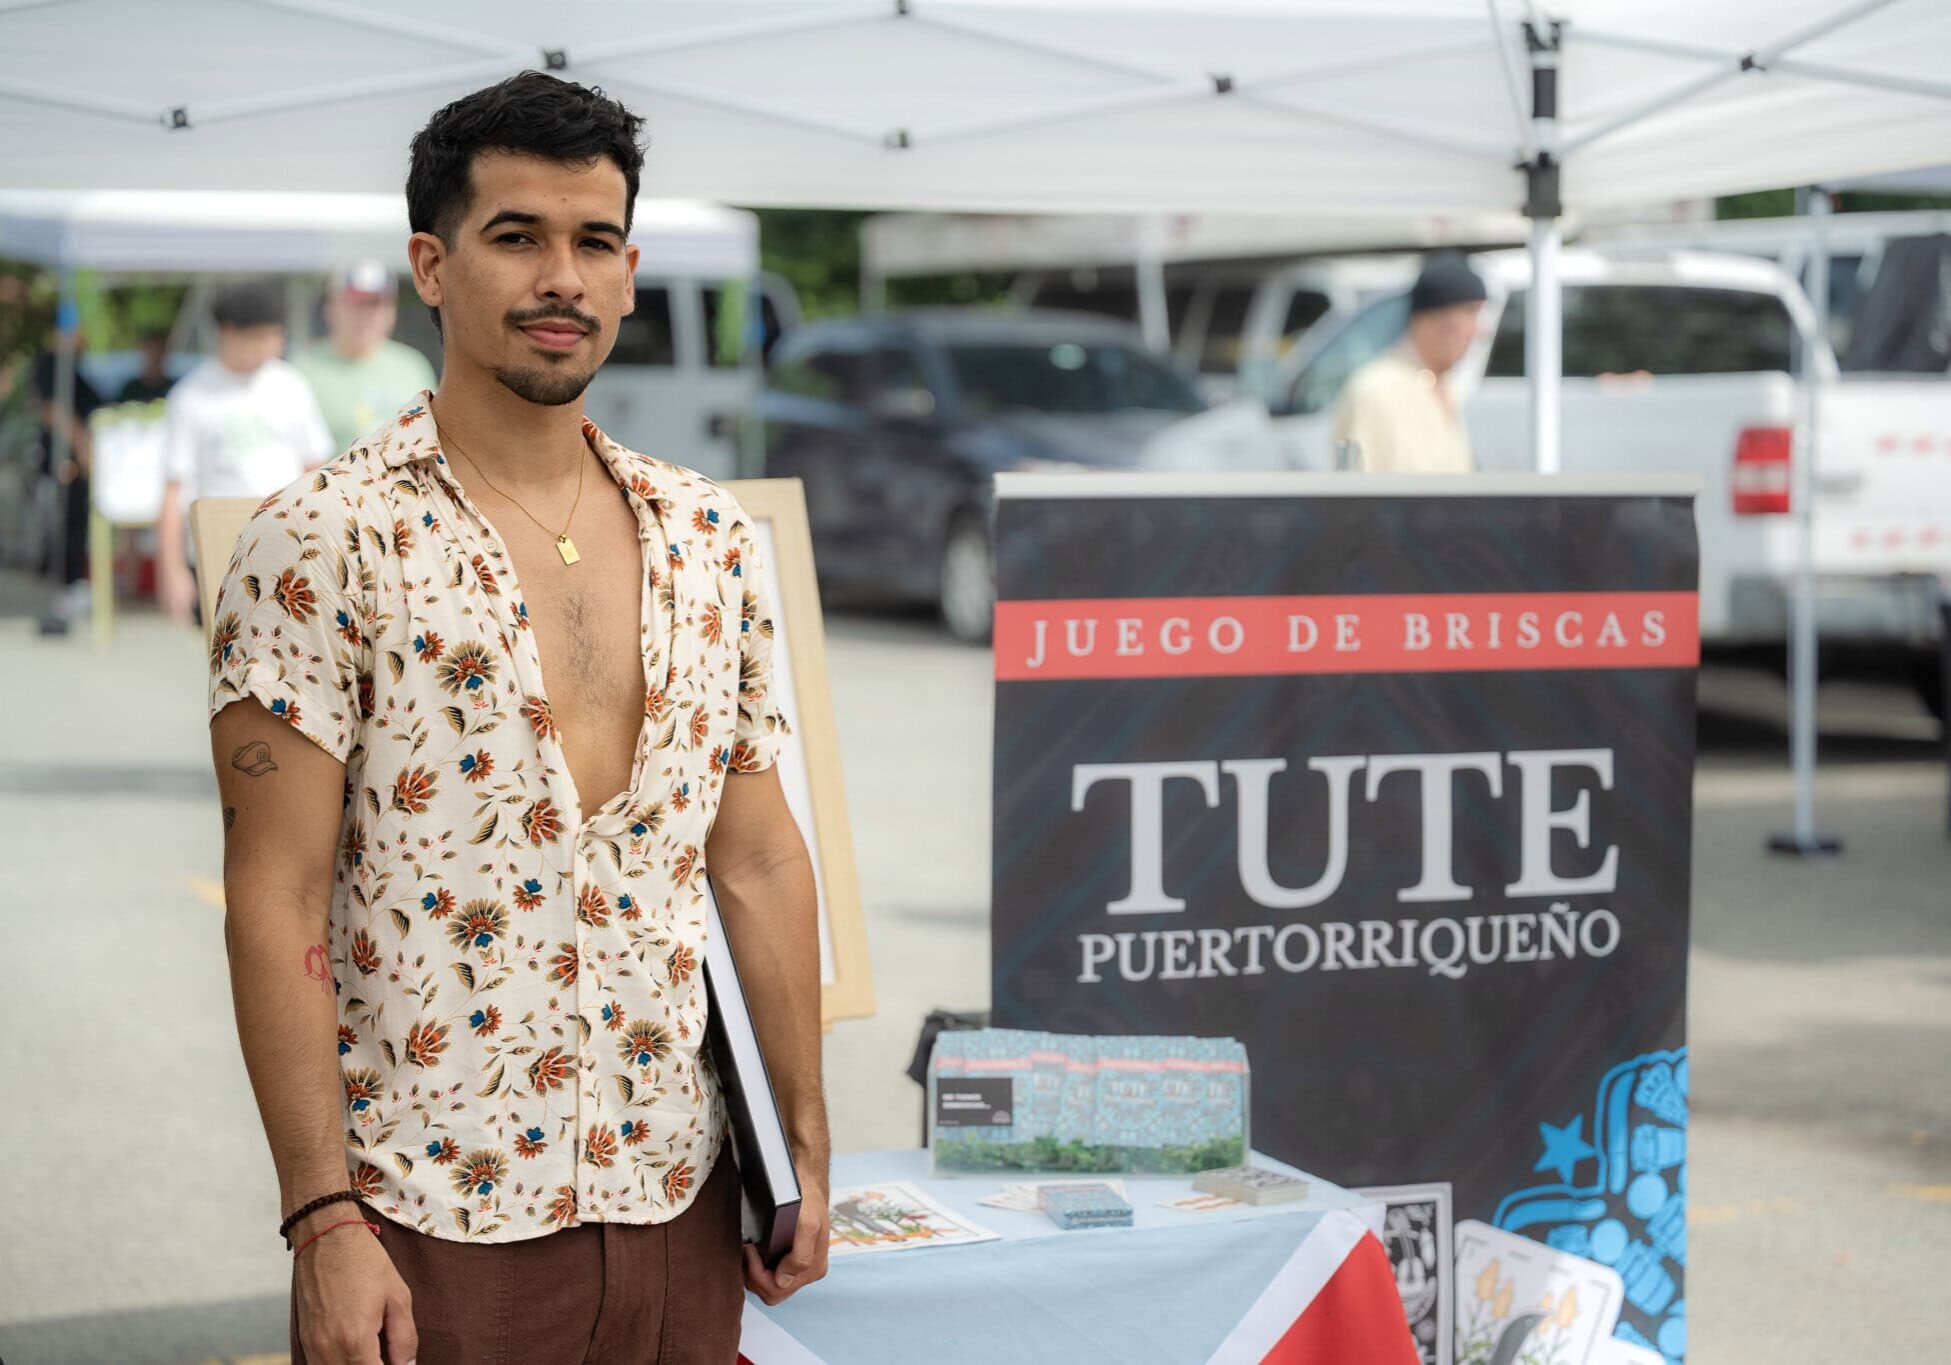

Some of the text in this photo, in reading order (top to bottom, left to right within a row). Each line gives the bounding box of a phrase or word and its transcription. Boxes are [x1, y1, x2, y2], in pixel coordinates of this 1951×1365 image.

[1025, 609, 1668, 669] JUEGO DE BRISCAS
[1071, 747, 1620, 916] TUTE
[1076, 901, 1621, 983] PUERTORRIQUEÑO
